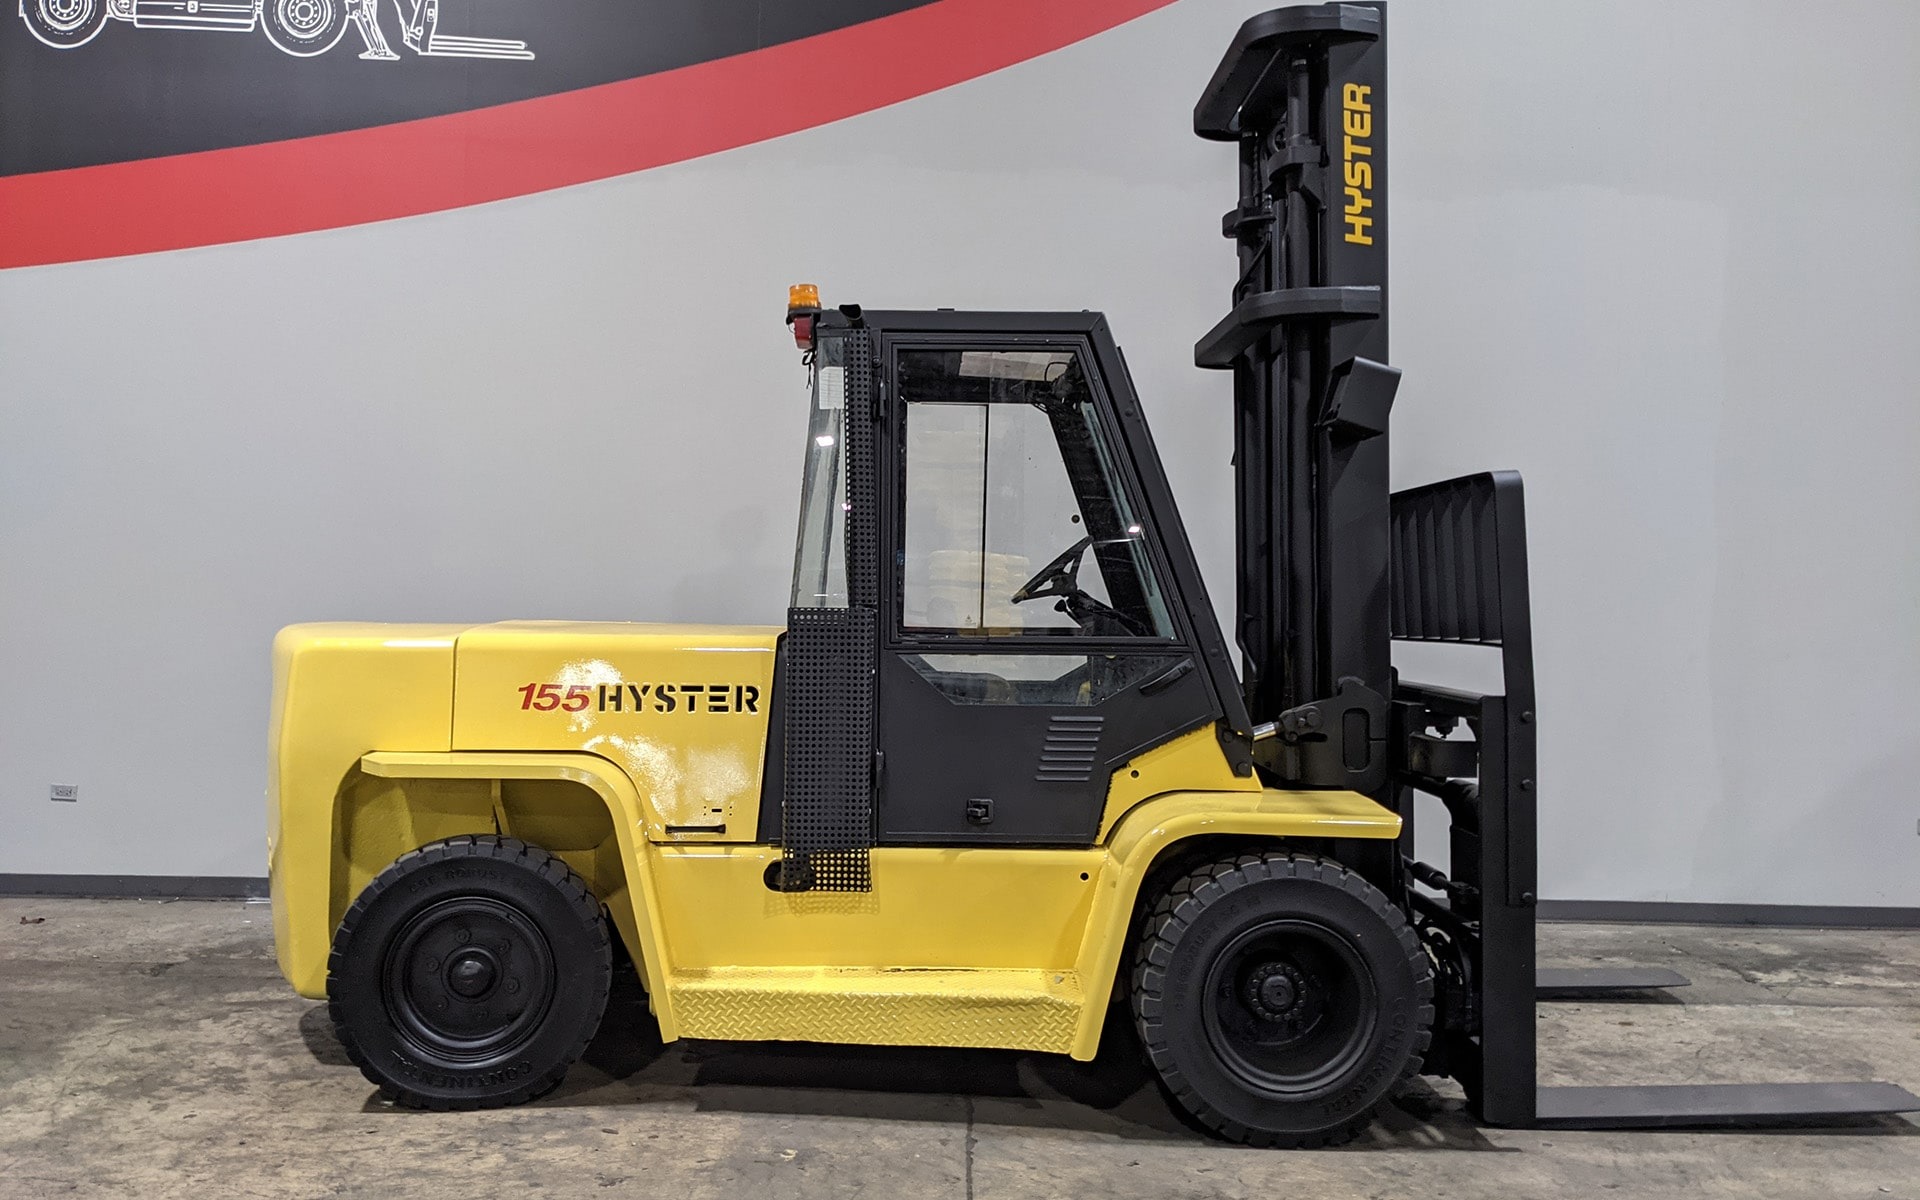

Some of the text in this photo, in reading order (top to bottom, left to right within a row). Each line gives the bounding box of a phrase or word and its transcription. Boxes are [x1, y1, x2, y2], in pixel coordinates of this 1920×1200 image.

[1343, 83, 1373, 245] HYSTER
[518, 683, 761, 714] 155 HYSTER
